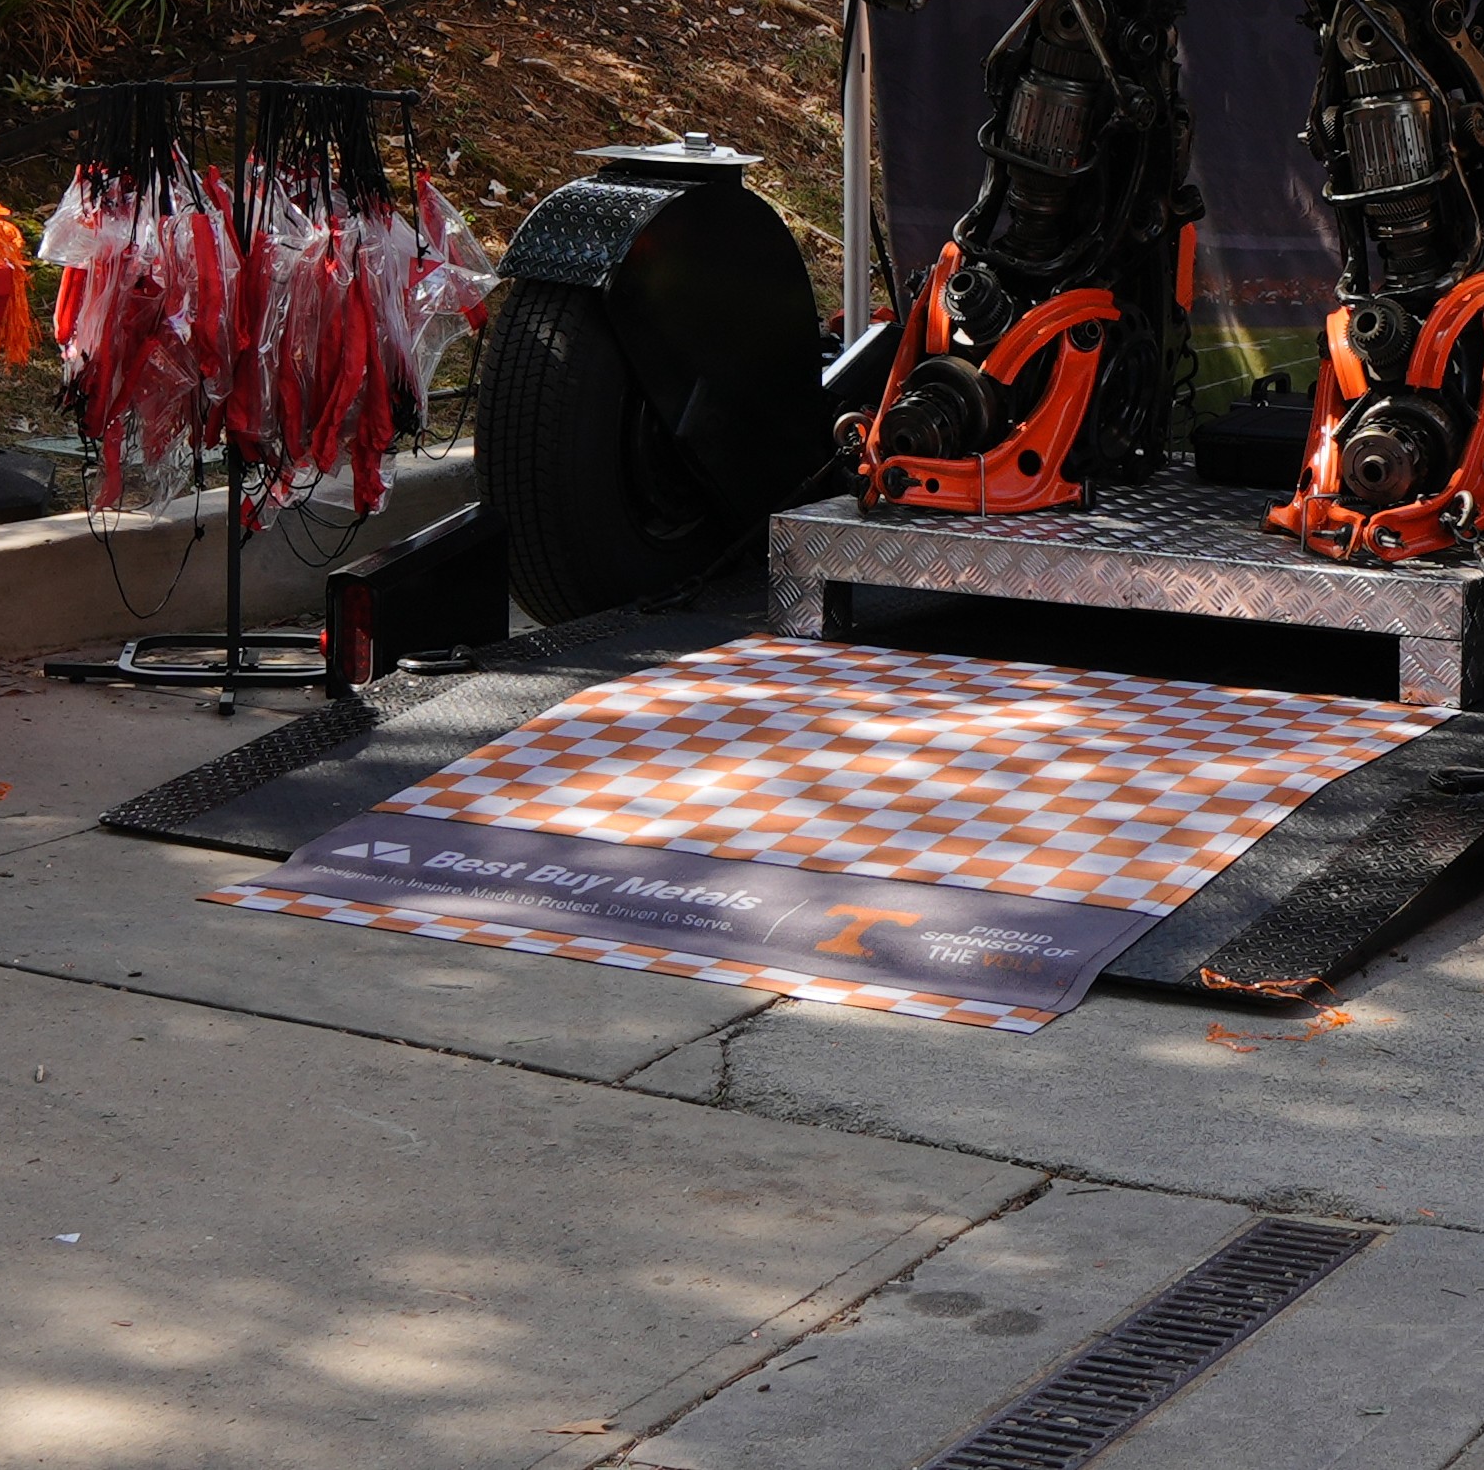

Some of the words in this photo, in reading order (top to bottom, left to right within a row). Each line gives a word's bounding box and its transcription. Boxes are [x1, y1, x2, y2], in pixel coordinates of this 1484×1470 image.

[424, 849, 528, 880] Best
[525, 863, 613, 896] Buy
[613, 876, 764, 911] Metals
[313, 863, 386, 884] Designed
[387, 875, 405, 886] to
[406, 877, 465, 897] Inspire.
[470, 886, 516, 904] Made
[518, 891, 535, 906] to
[537, 894, 601, 916] Protect.
[606, 904, 658, 923] Driven
[661, 910, 679, 924] to
[682, 914, 734, 933] Serve.
[920, 930, 1039, 955] SPONSOR
[1042, 947, 1080, 959] OF
[968, 925, 1053, 945] PROUD
[928, 944, 978, 965] THE
